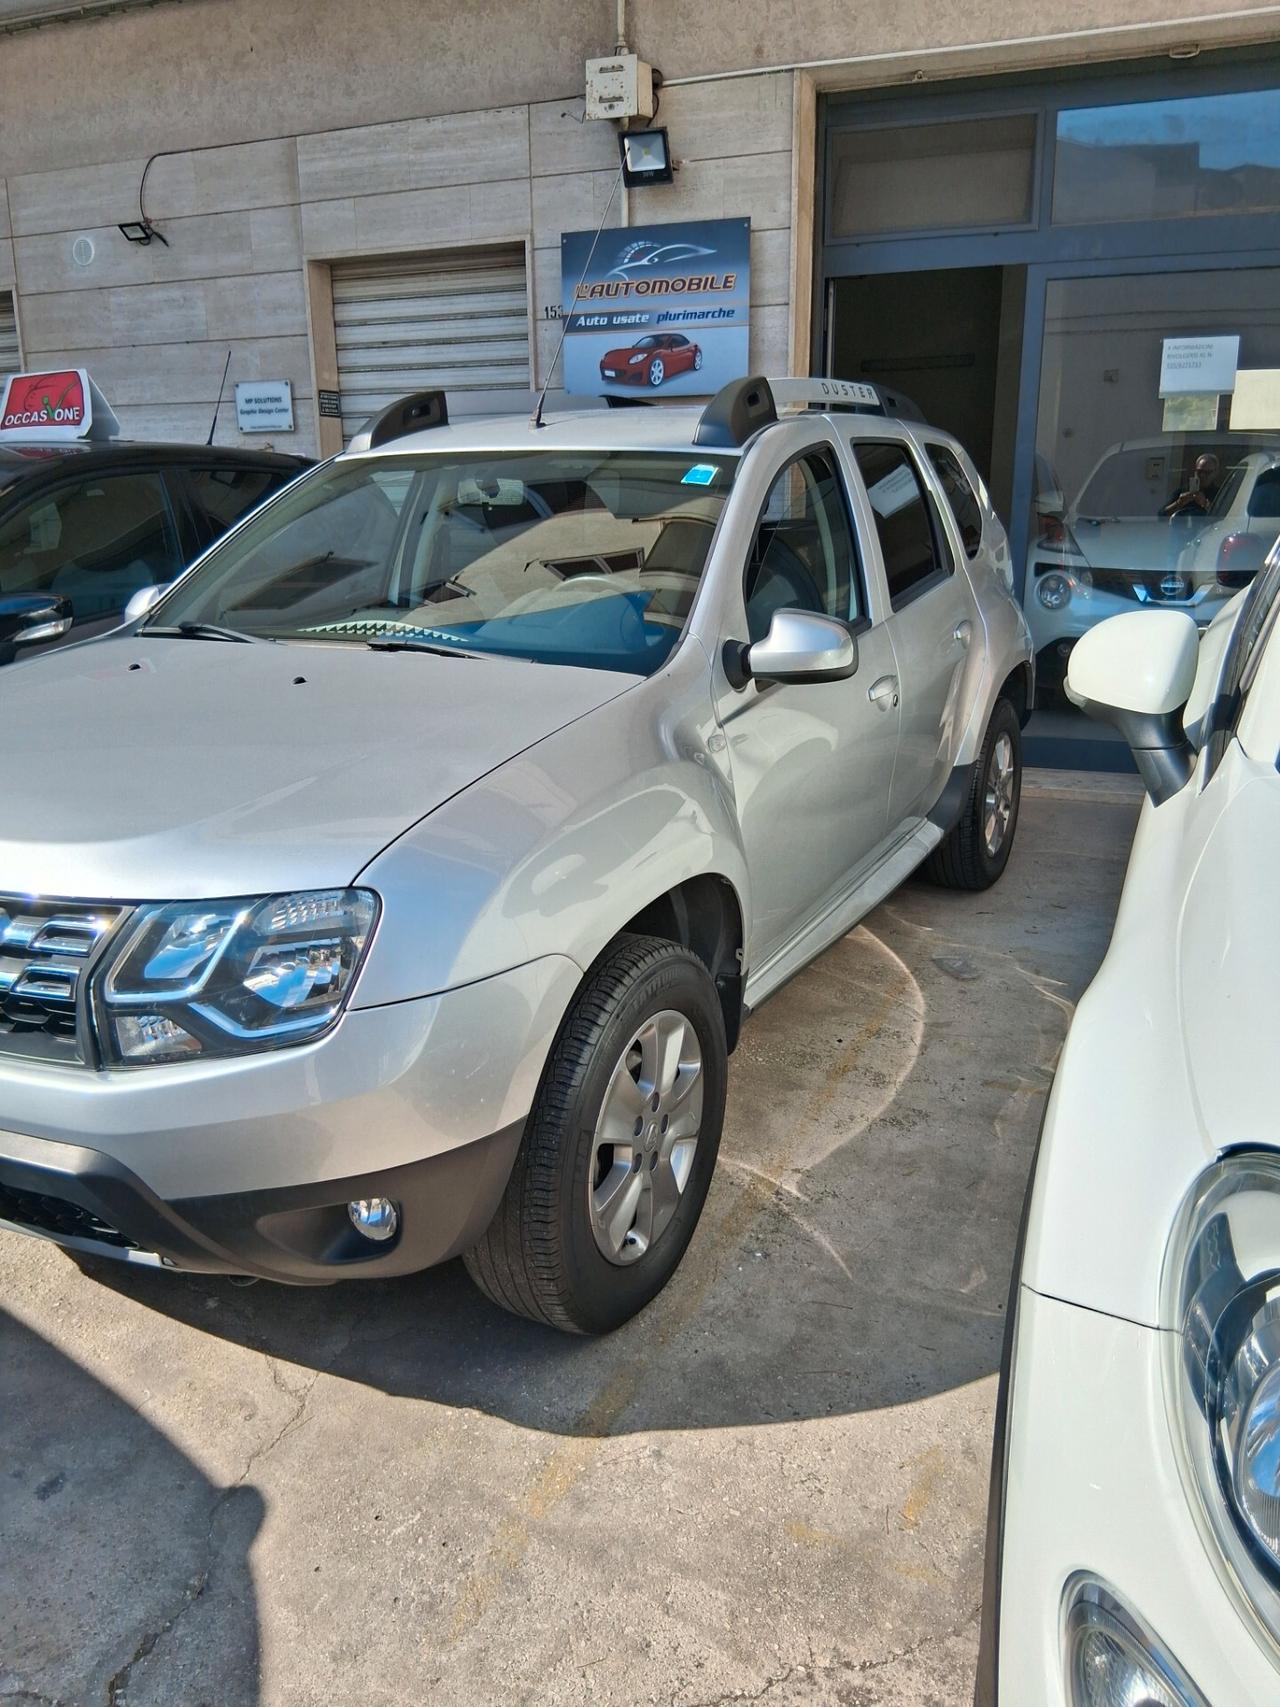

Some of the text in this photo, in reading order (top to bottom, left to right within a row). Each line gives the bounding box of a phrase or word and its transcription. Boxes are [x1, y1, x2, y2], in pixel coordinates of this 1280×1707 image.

[575, 273, 737, 300] L'AUTOMOBILE
[576, 307, 735, 327] Auto usate plurimarche
[821, 382, 874, 399] DUSTER
[254, 396, 282, 404] SOLUTIONS
